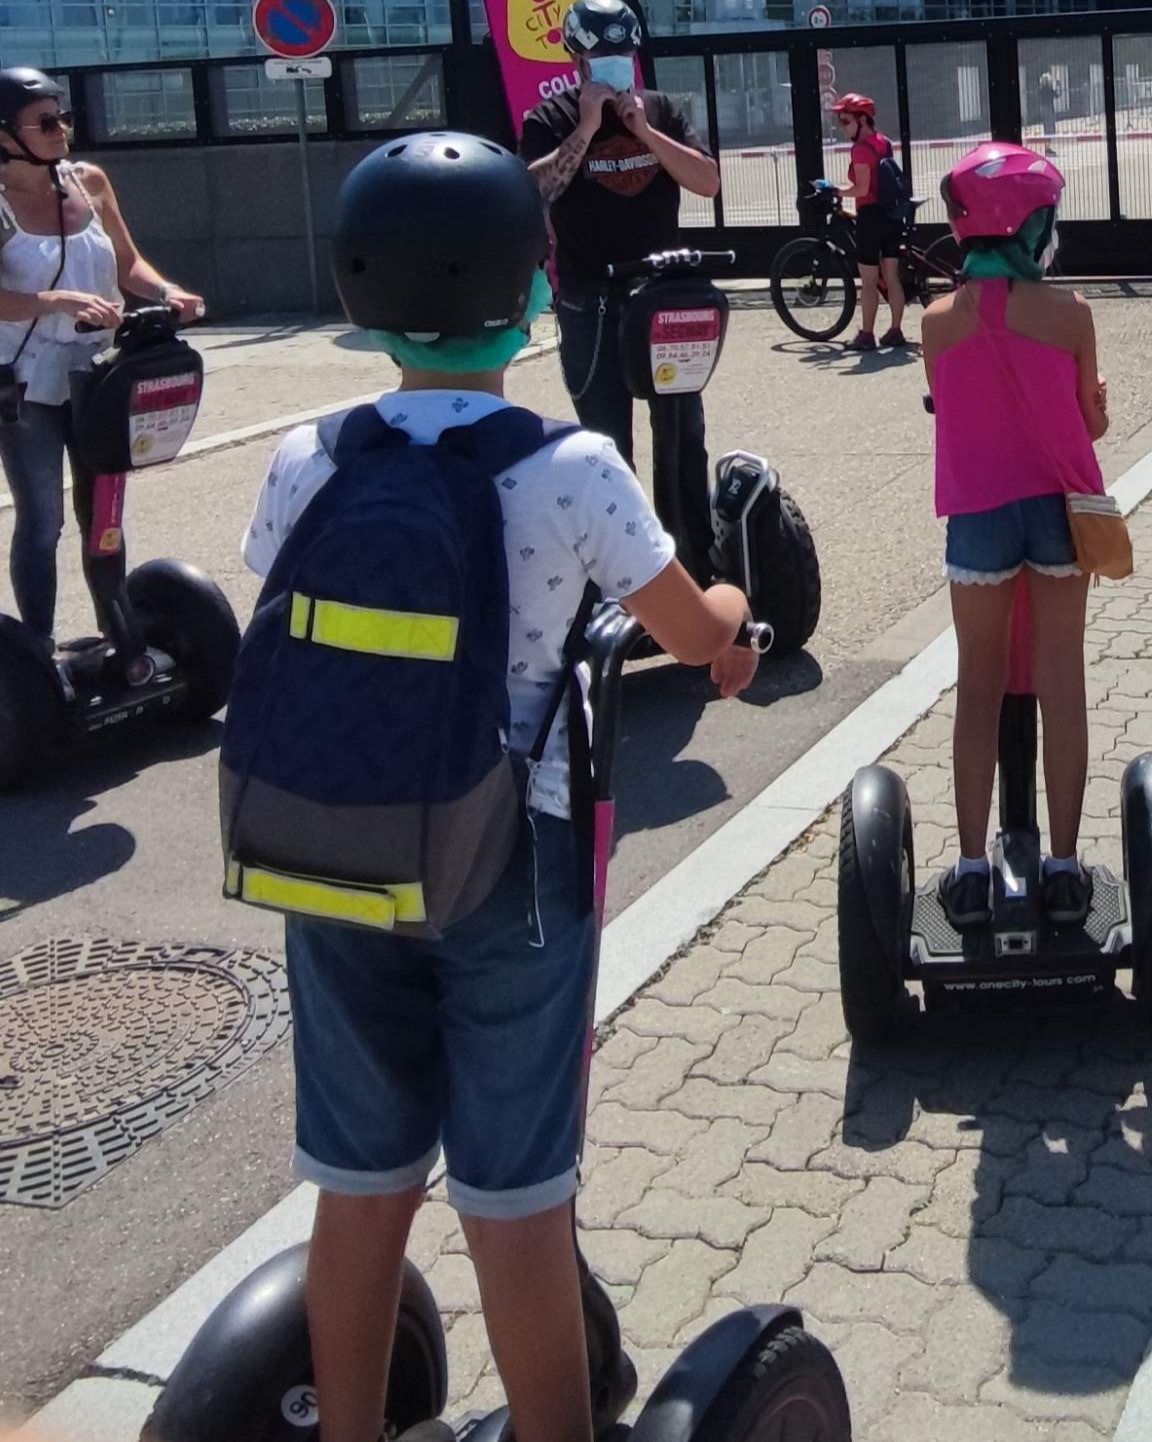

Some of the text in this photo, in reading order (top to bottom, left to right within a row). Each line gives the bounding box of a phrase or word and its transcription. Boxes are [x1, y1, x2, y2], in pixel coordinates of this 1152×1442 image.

[525, 0, 561, 32] CITY
[535, 27, 562, 49] TO
[657, 309, 715, 325] STRASBOURG
